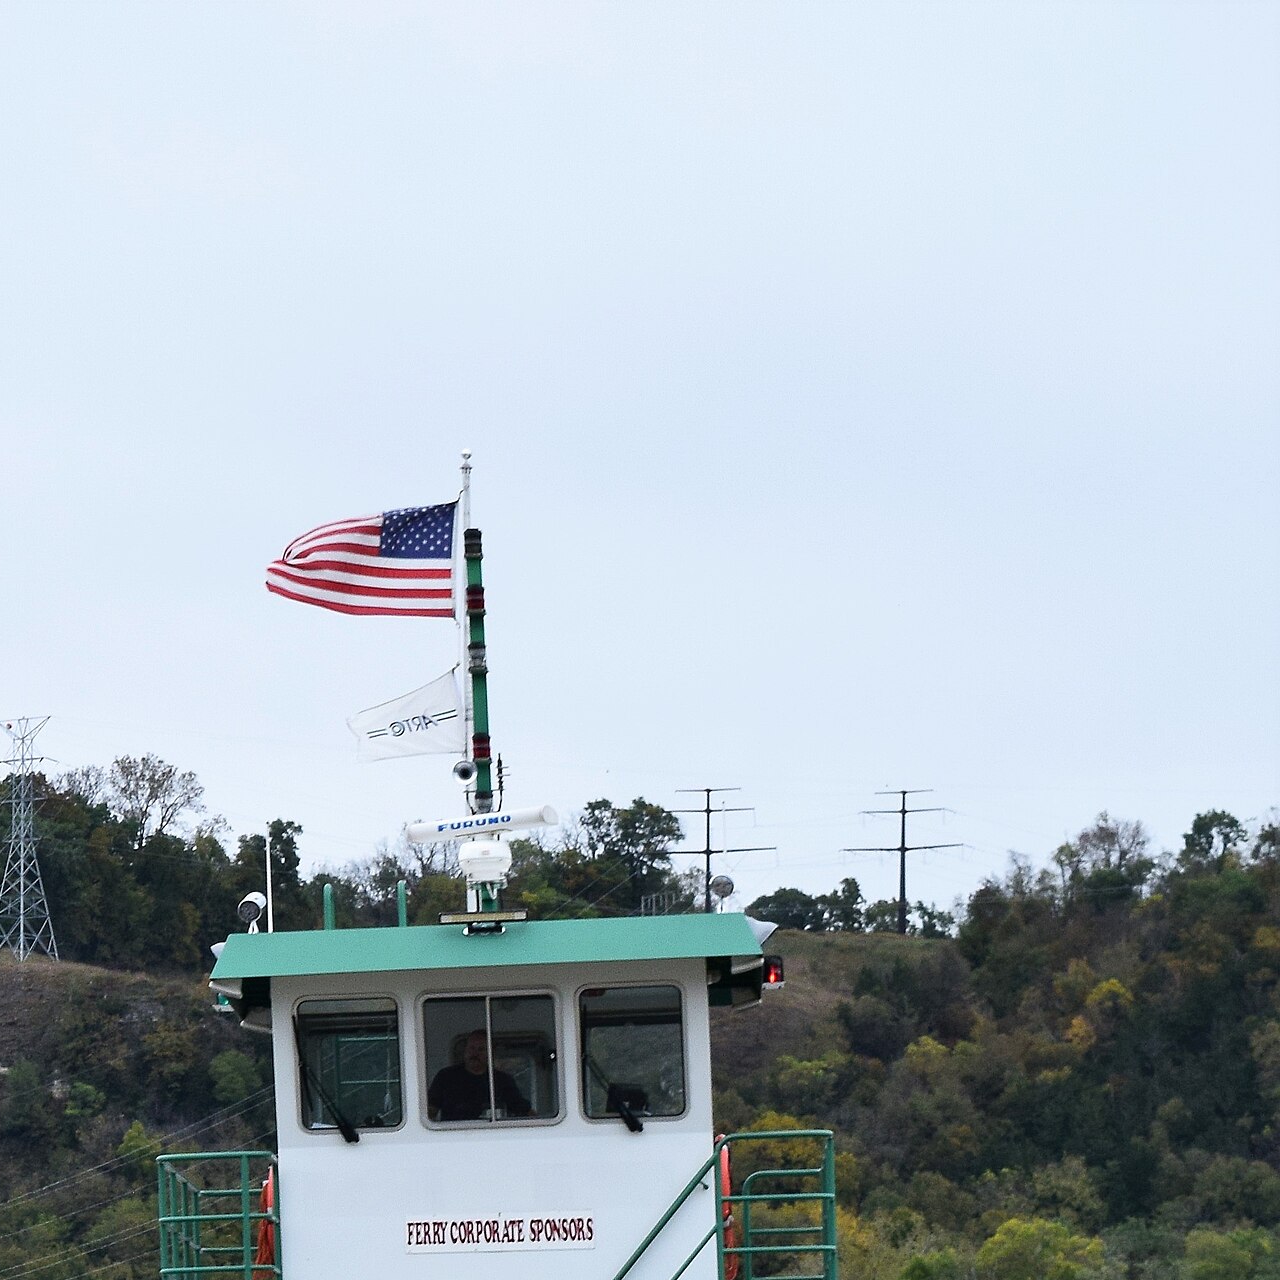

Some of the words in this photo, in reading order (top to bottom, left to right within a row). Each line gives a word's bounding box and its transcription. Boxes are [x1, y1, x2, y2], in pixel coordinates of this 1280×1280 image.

[438, 815, 511, 832] FURUNO
[407, 1222, 447, 1245] FERRY
[450, 1220, 524, 1243] CORPORATE
[529, 1218, 593, 1242] SPONSORS
